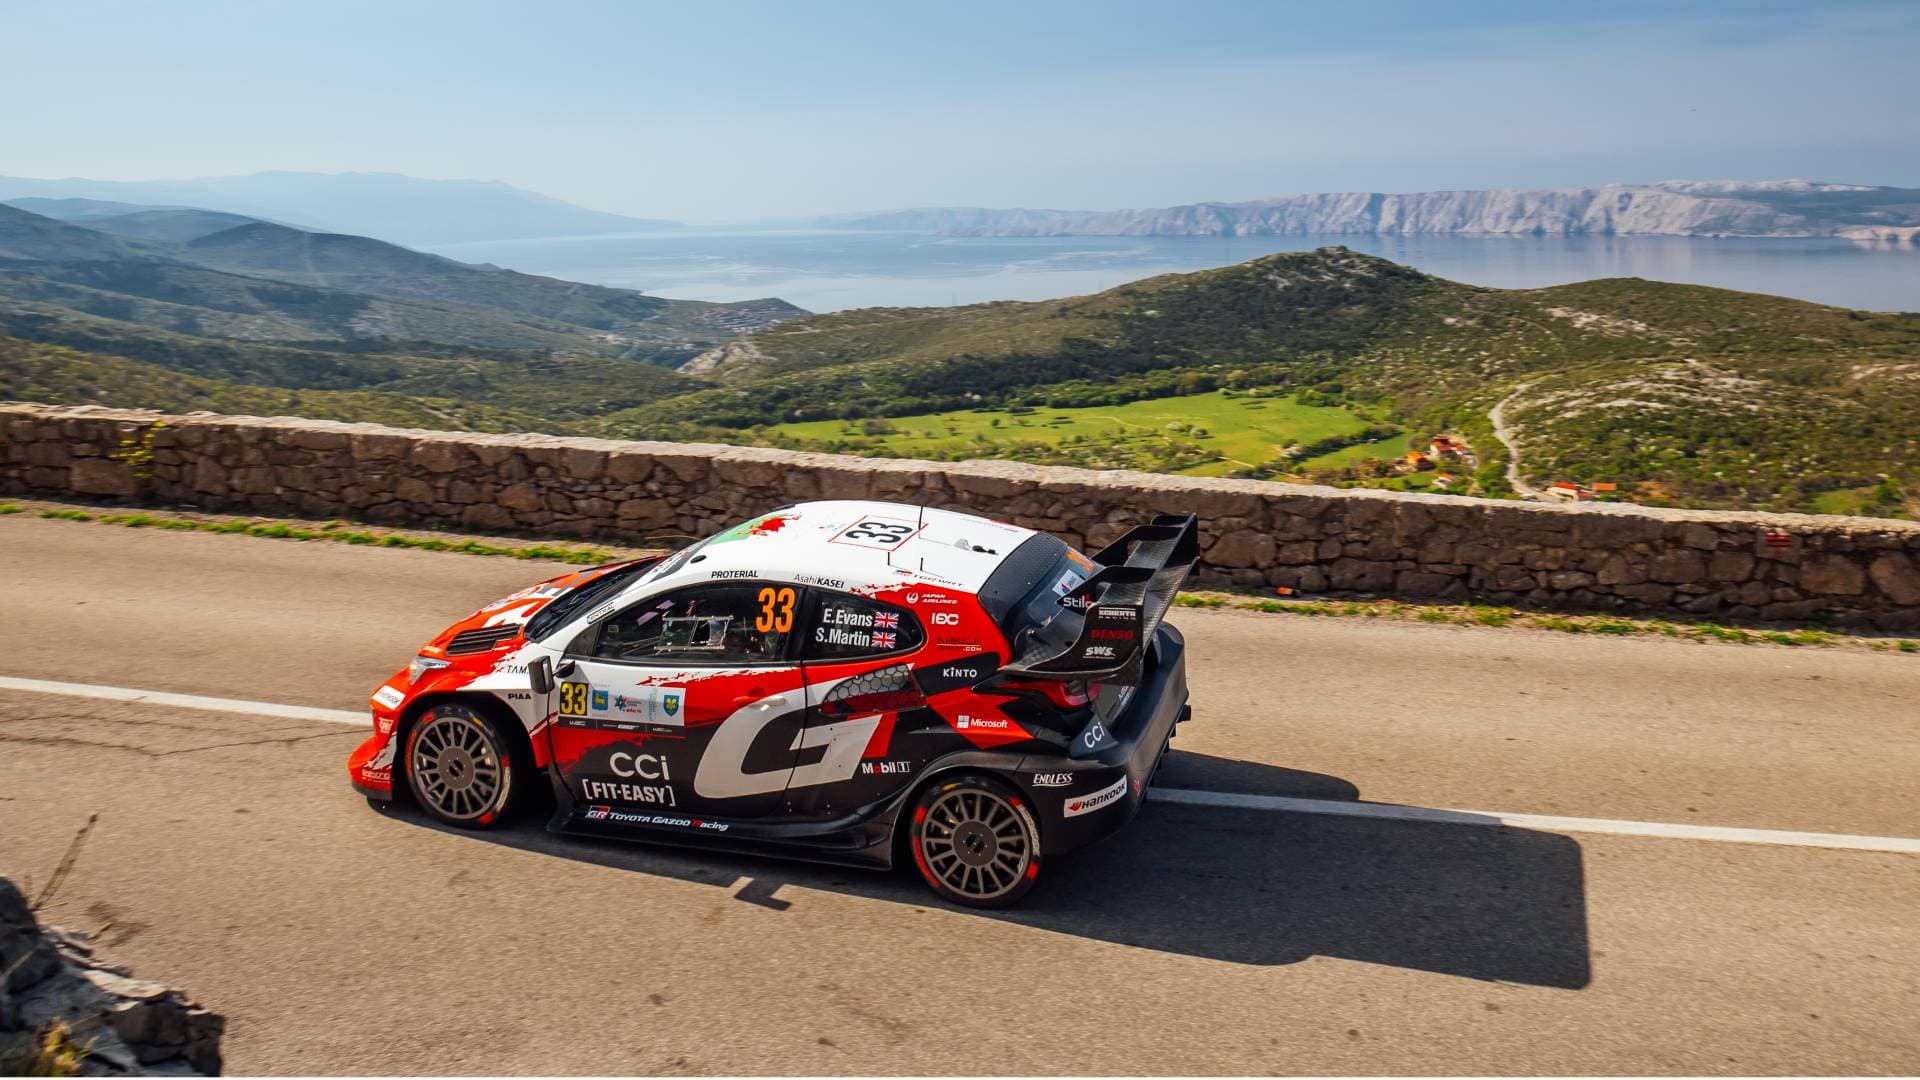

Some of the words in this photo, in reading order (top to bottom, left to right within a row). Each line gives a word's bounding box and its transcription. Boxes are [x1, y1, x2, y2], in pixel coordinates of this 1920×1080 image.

[845, 521, 913, 543] 33
[711, 570, 759, 578] PROTERIAL
[755, 587, 796, 633] 33
[823, 608, 873, 627] E.Evans
[815, 627, 870, 647] S.Martin
[1090, 629, 1134, 640] DENSO
[1085, 646, 1114, 656] SWS
[507, 665, 529, 675] TAM
[560, 682, 587, 715] 33
[970, 718, 1008, 728] Microsoft
[861, 762, 897, 774] Mobil
[1033, 773, 1073, 784] ENDLESS
[585, 808, 608, 819] GR
[609, 812, 651, 823] TOYOTA
[691, 819, 729, 832] Racing
